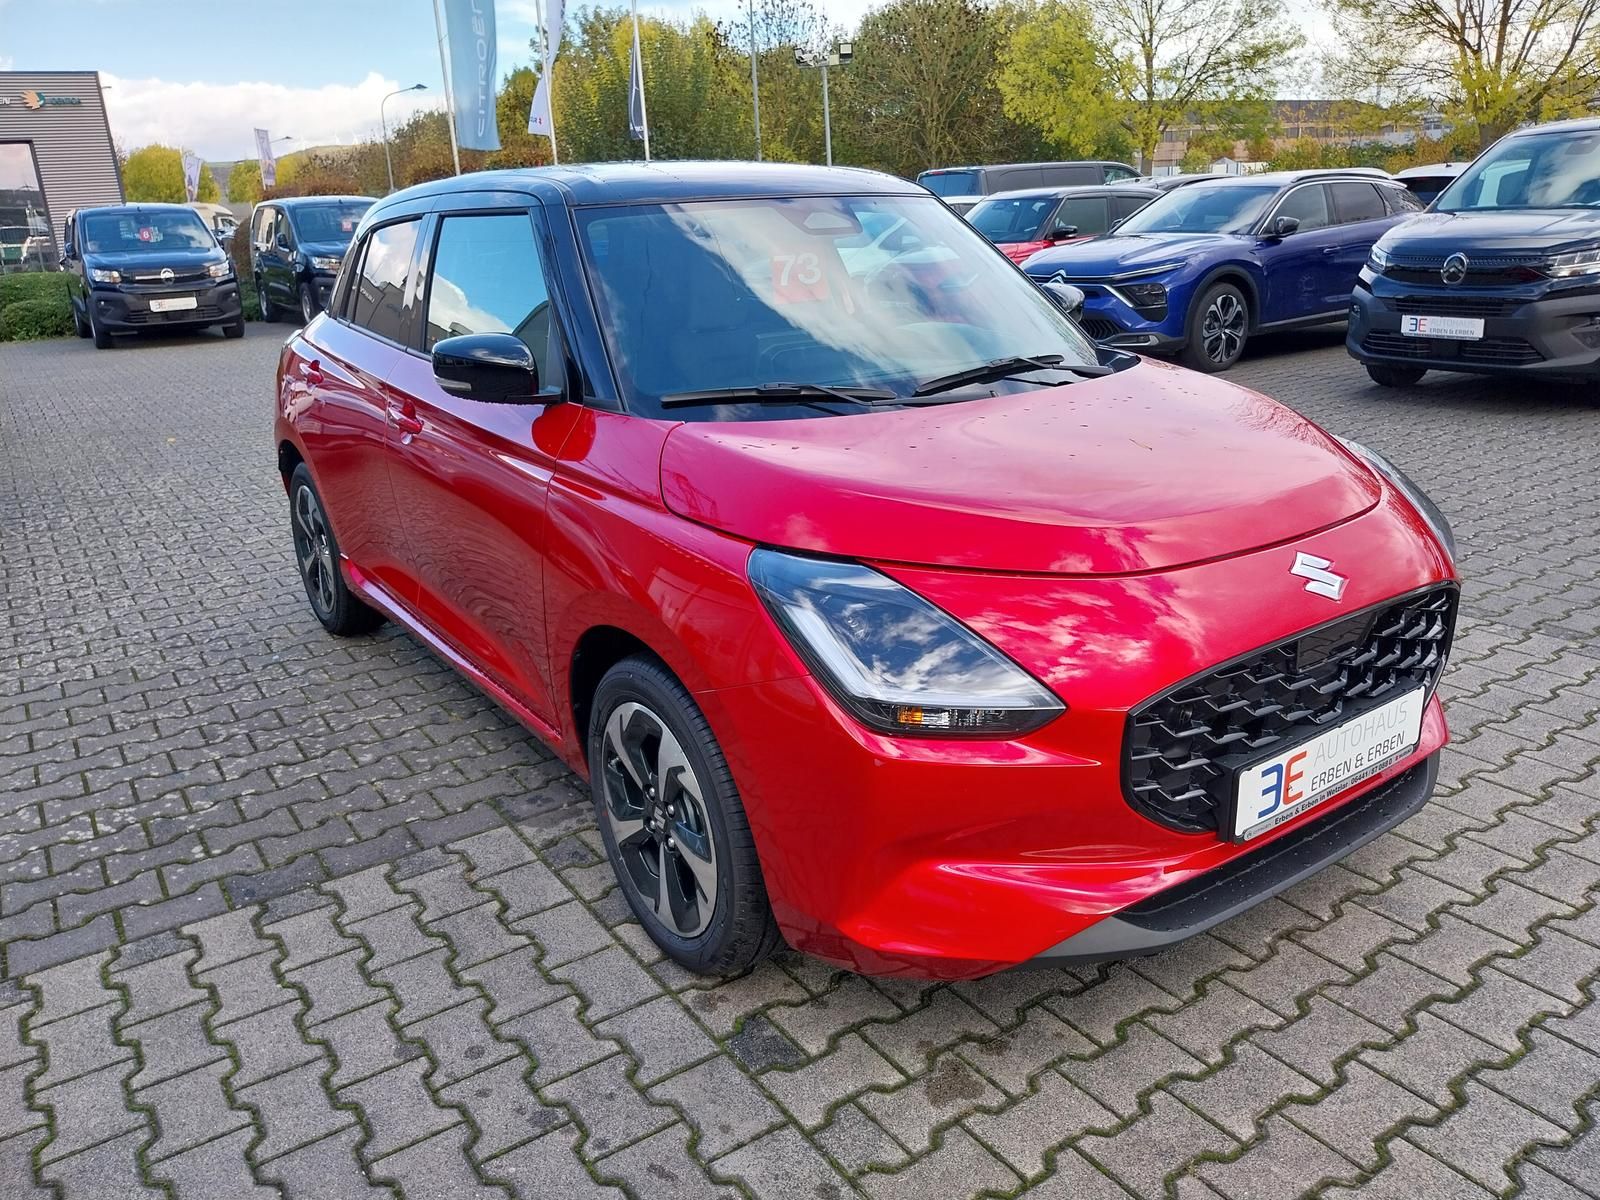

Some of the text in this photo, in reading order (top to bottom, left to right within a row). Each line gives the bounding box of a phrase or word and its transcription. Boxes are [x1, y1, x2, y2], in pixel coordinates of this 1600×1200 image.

[773, 252, 822, 287] 73
[1314, 700, 1408, 767] AUTOHAUS
[1311, 758, 1352, 791] ERBEN
[1354, 753, 1364, 769] &
[1367, 730, 1404, 762] ERBEN
[1274, 811, 1294, 825] Erben
[1295, 807, 1300, 815] &
[1301, 798, 1319, 811] Erben
